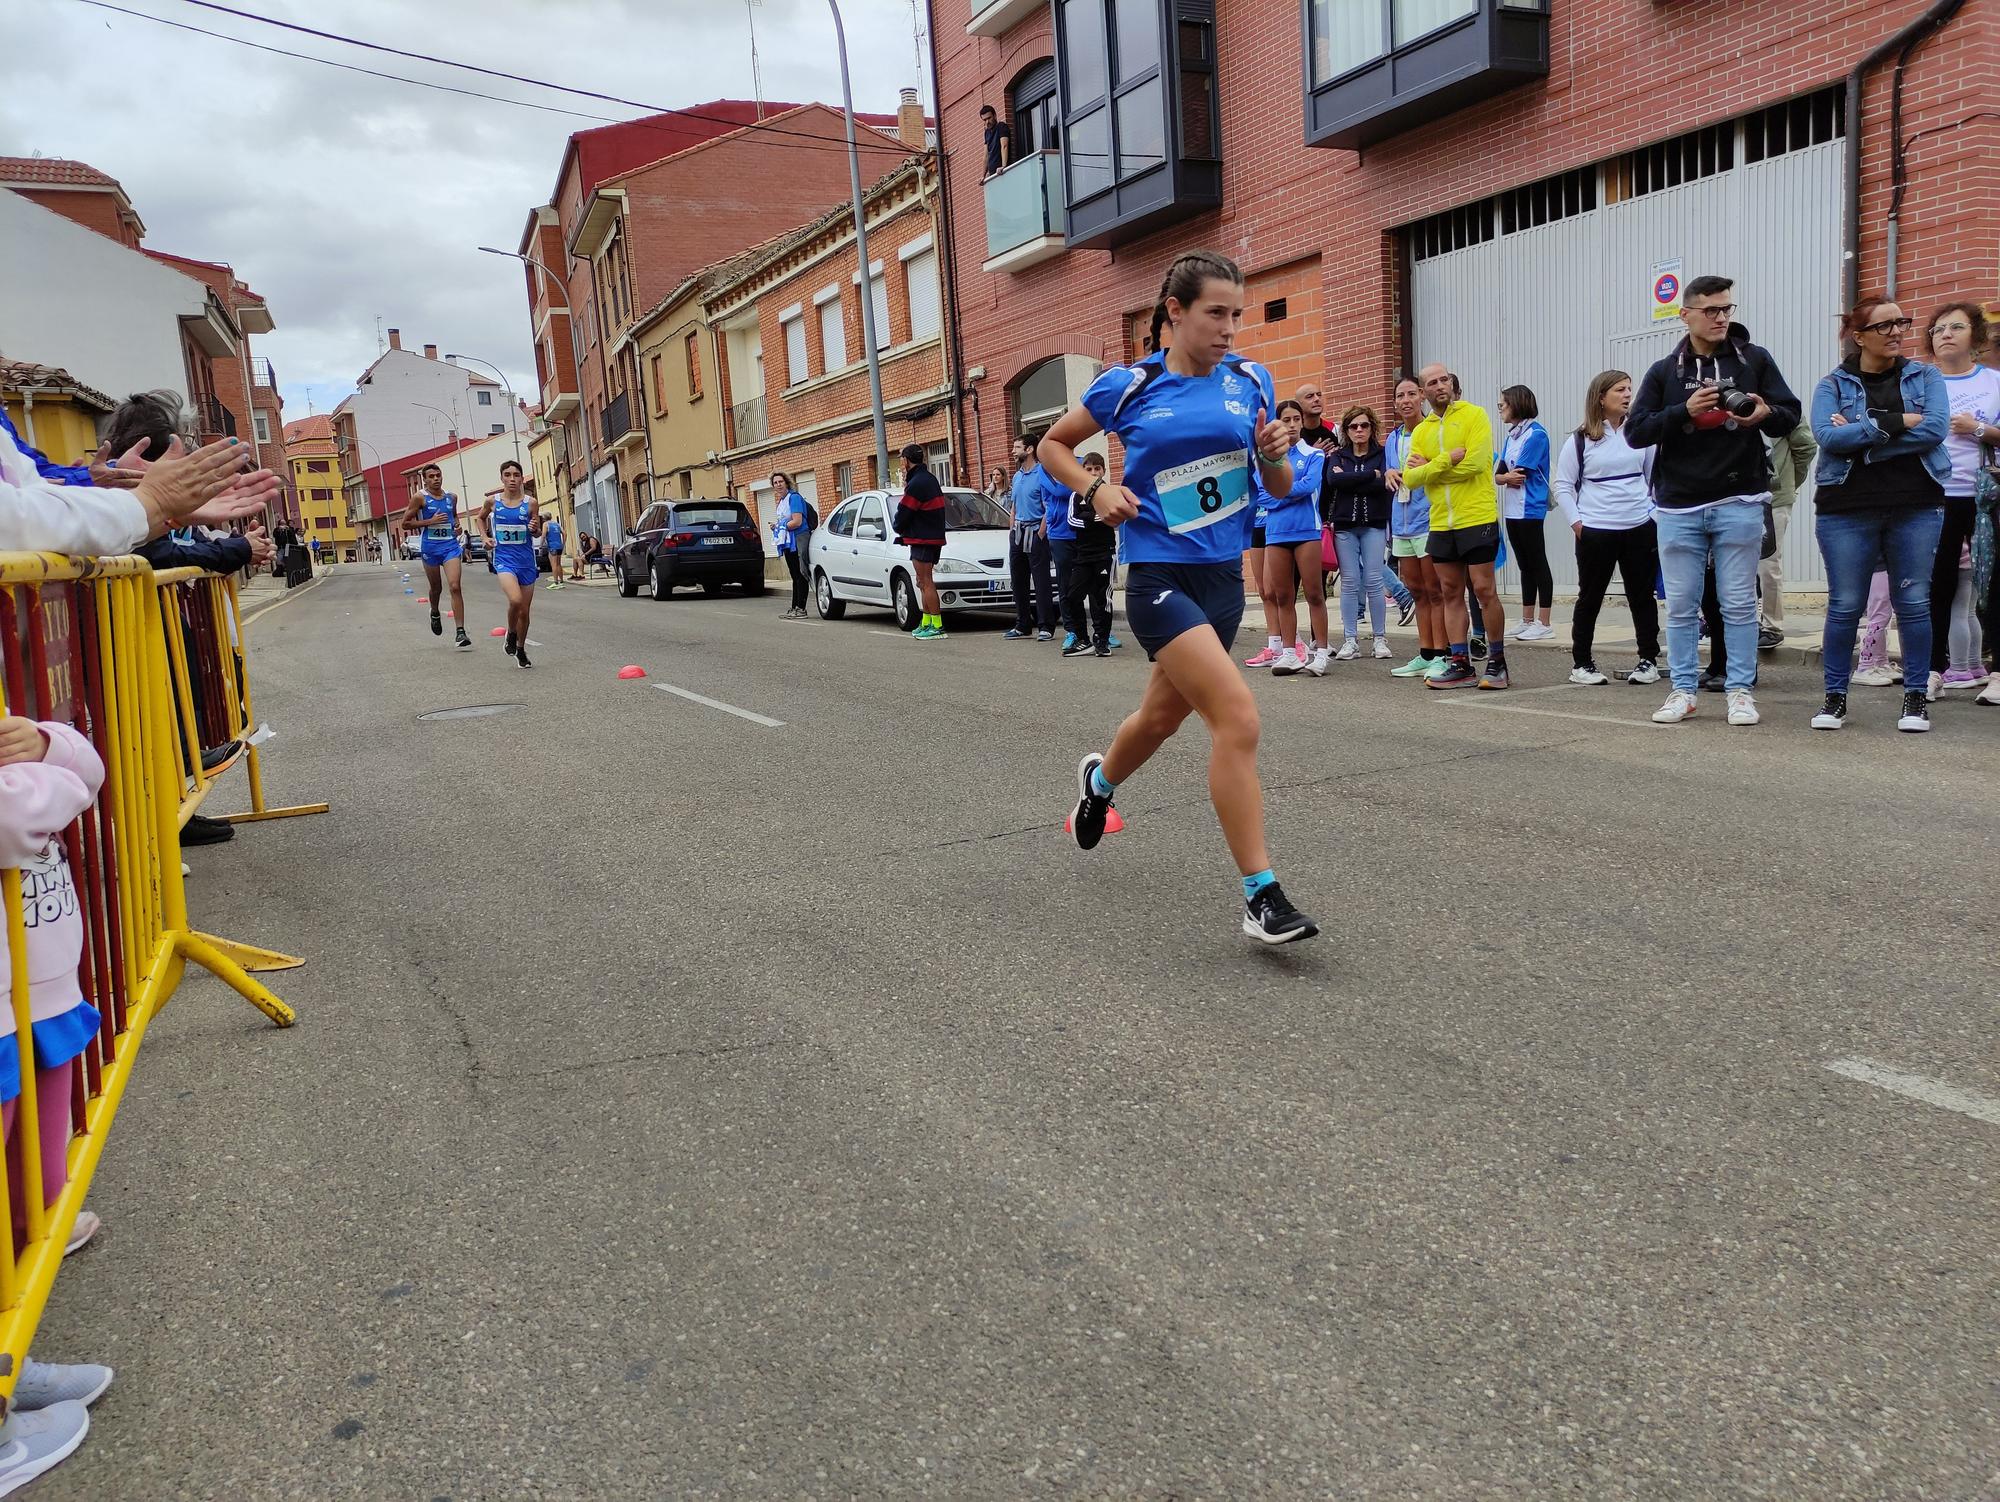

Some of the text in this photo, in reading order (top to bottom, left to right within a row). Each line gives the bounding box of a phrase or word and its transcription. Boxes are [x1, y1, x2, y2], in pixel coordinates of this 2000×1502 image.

[1170, 464, 1200, 478] PLAZA
[1203, 454, 1232, 468] MAYOR
[1196, 476, 1223, 514] 8
[432, 528, 449, 538] 48
[502, 530, 520, 542] 31
[995, 581, 1006, 591] ZA
[44, 599, 70, 644] YTO
